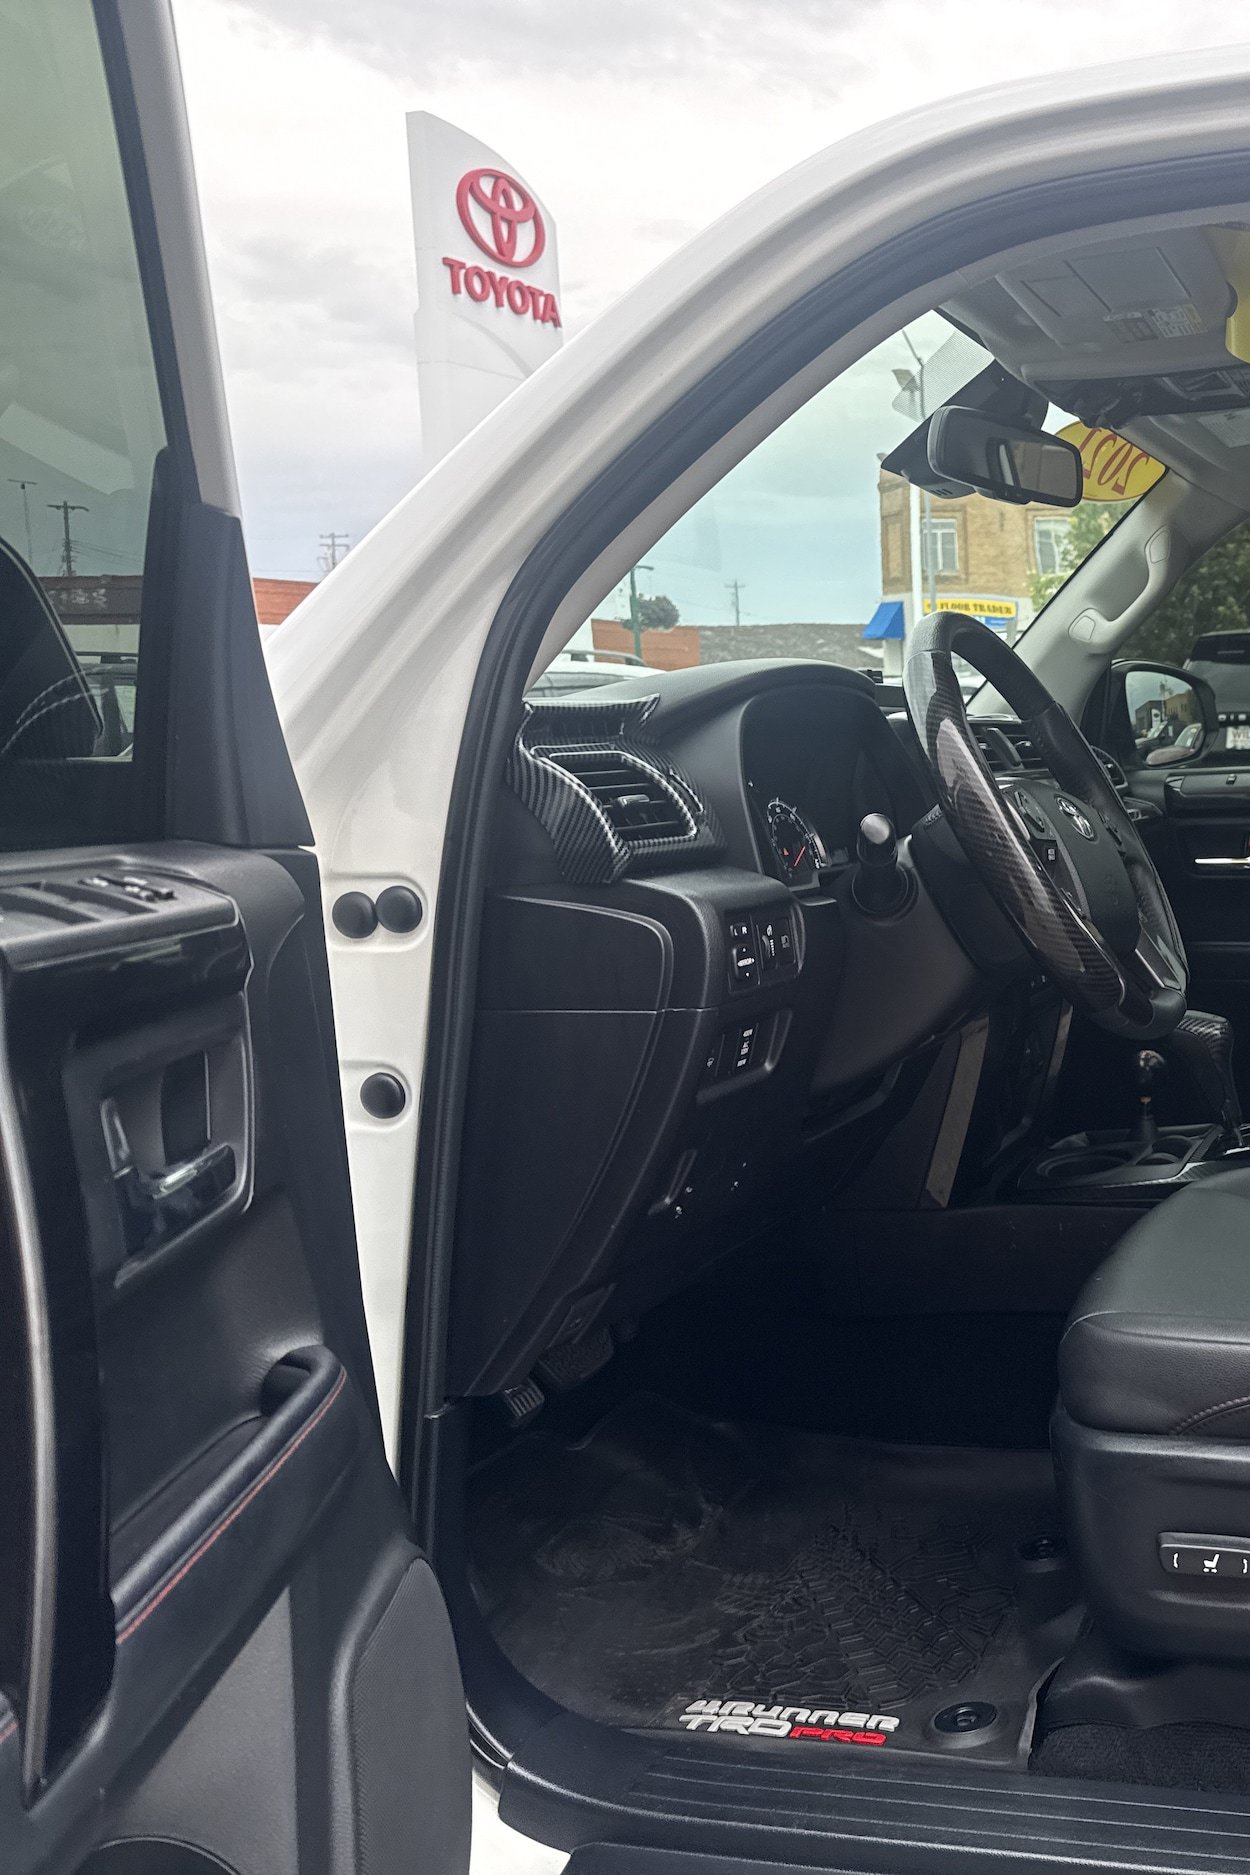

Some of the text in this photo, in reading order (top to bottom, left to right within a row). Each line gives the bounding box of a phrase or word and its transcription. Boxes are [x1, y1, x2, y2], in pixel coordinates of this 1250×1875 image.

[442, 257, 561, 328] TOYOTA
[679, 1714, 889, 1746] TRD PRO
[685, 1699, 900, 1732] 4RUNNER
